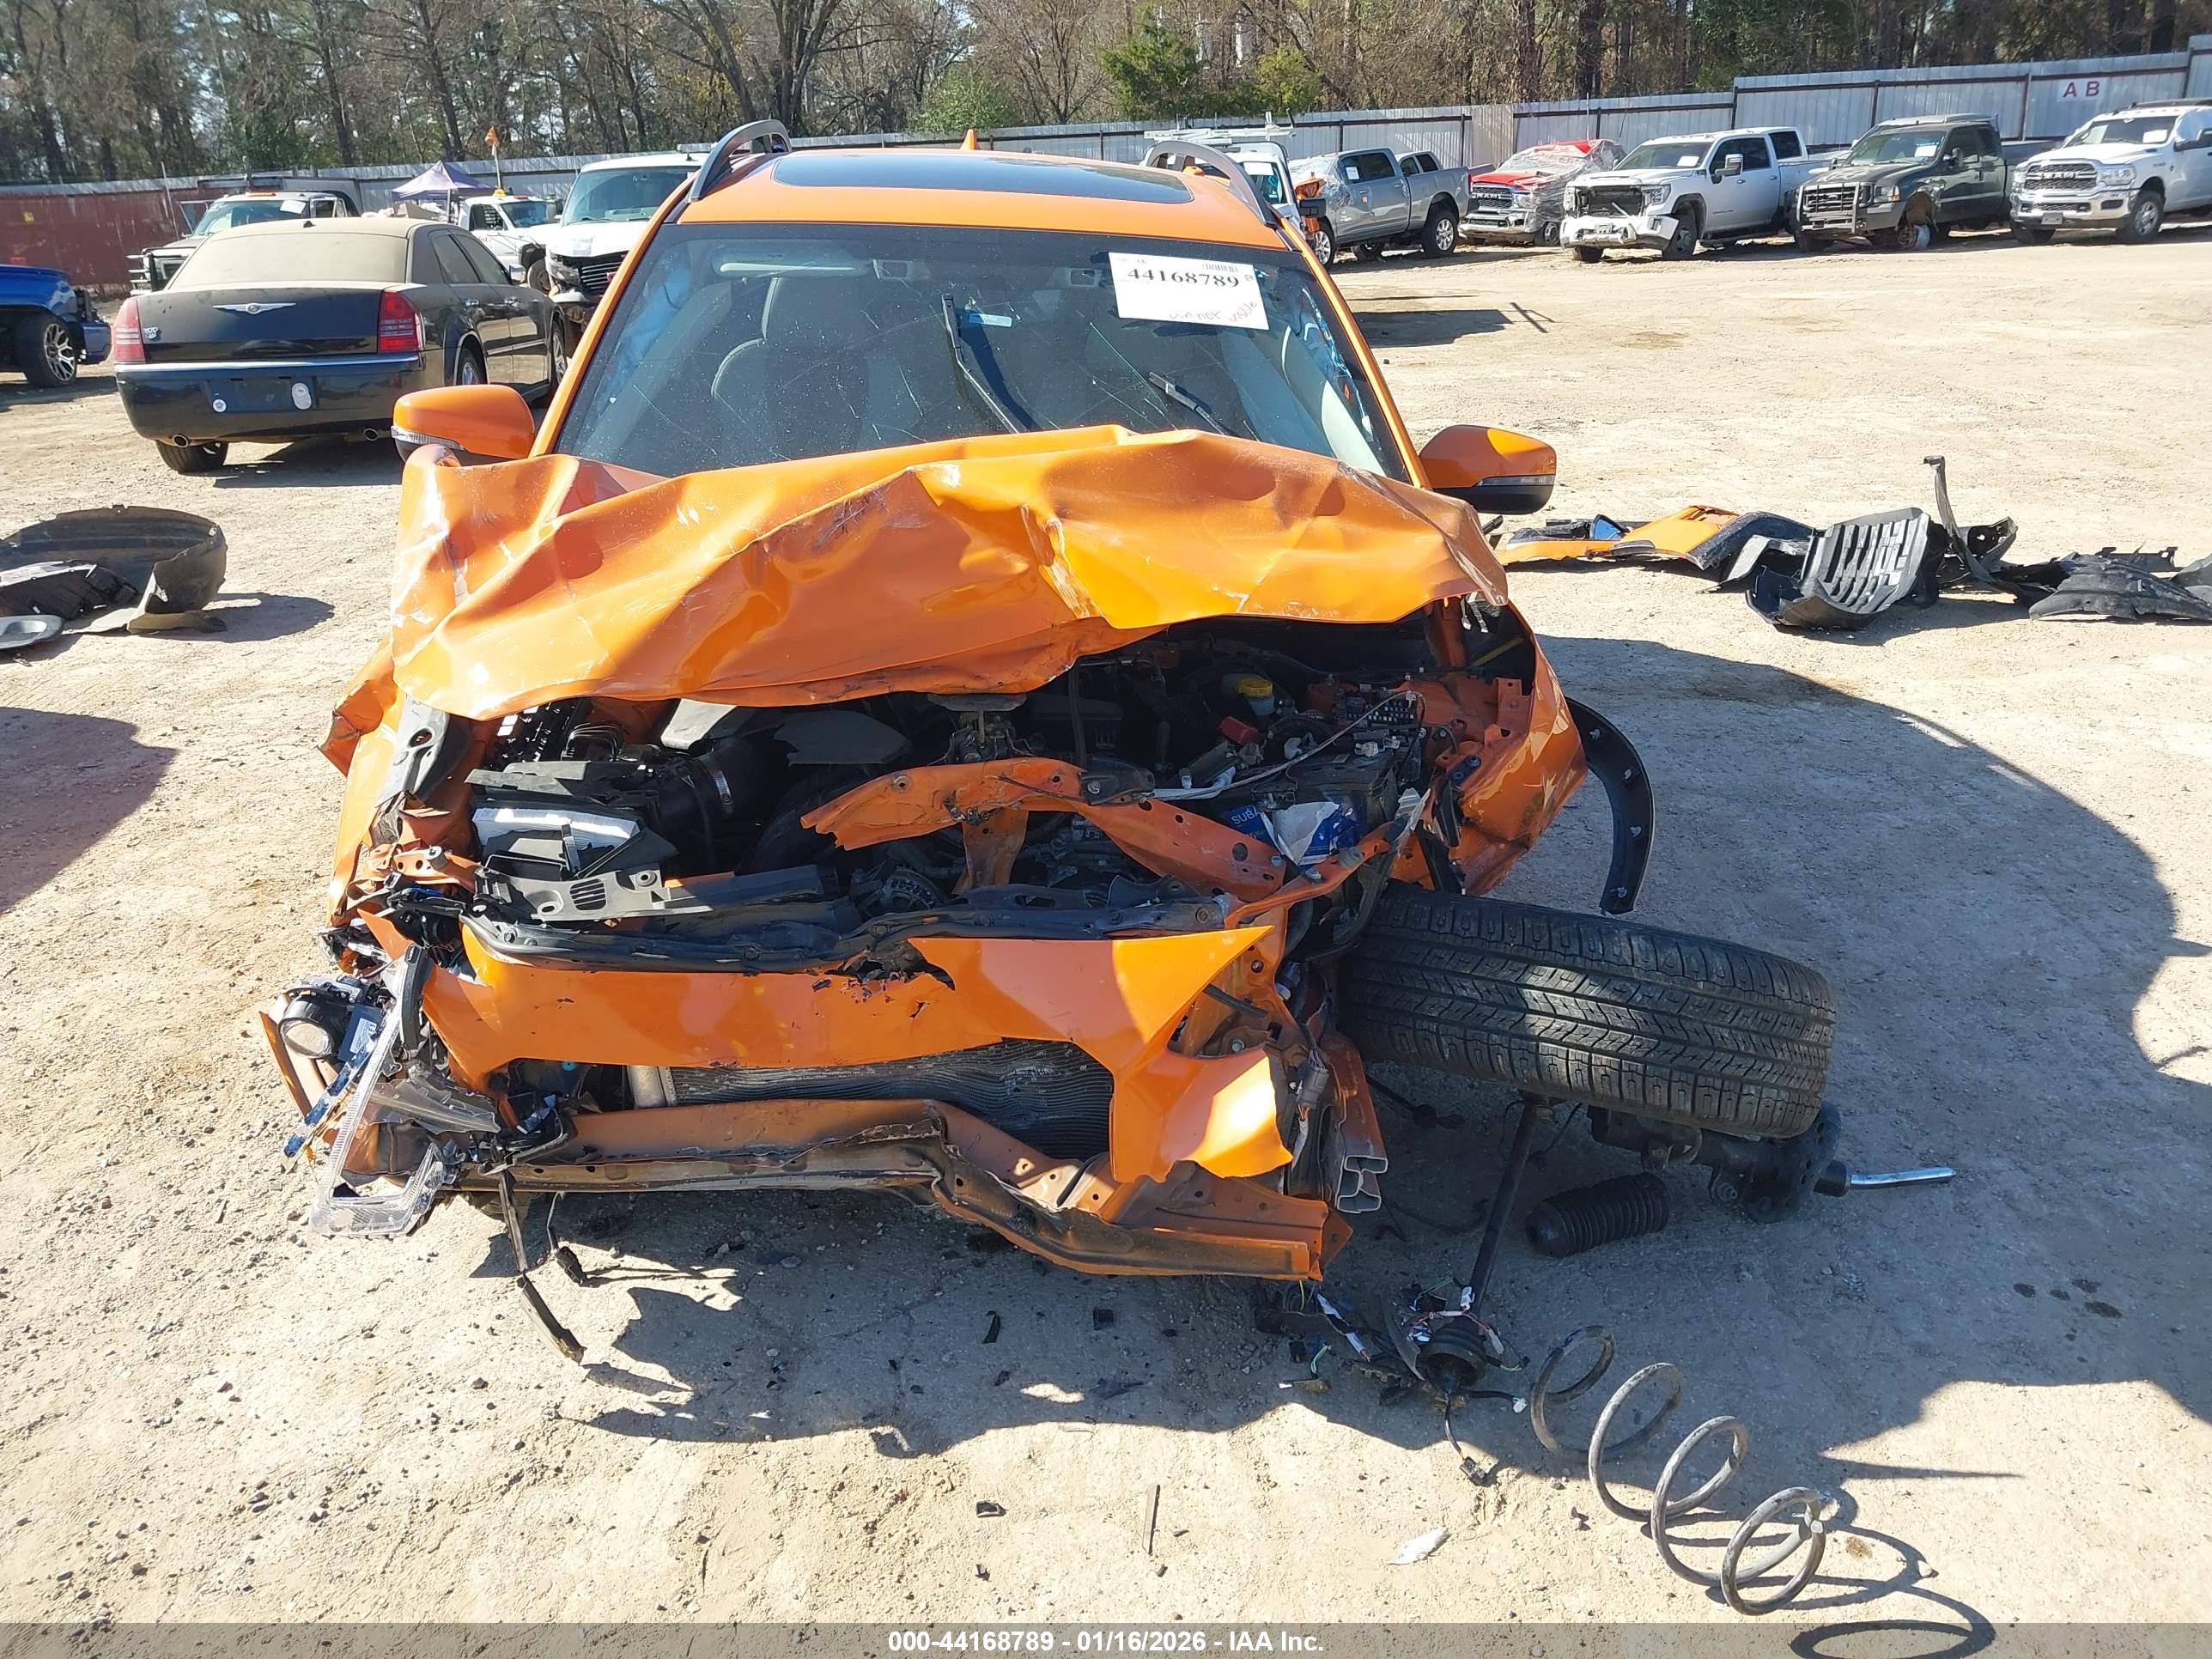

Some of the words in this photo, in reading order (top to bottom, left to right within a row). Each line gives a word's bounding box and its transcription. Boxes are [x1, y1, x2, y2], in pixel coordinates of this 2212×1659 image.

[2063, 82, 2077, 97] A
[2086, 81, 2100, 97] B
[1127, 268, 1240, 288] 44168789
